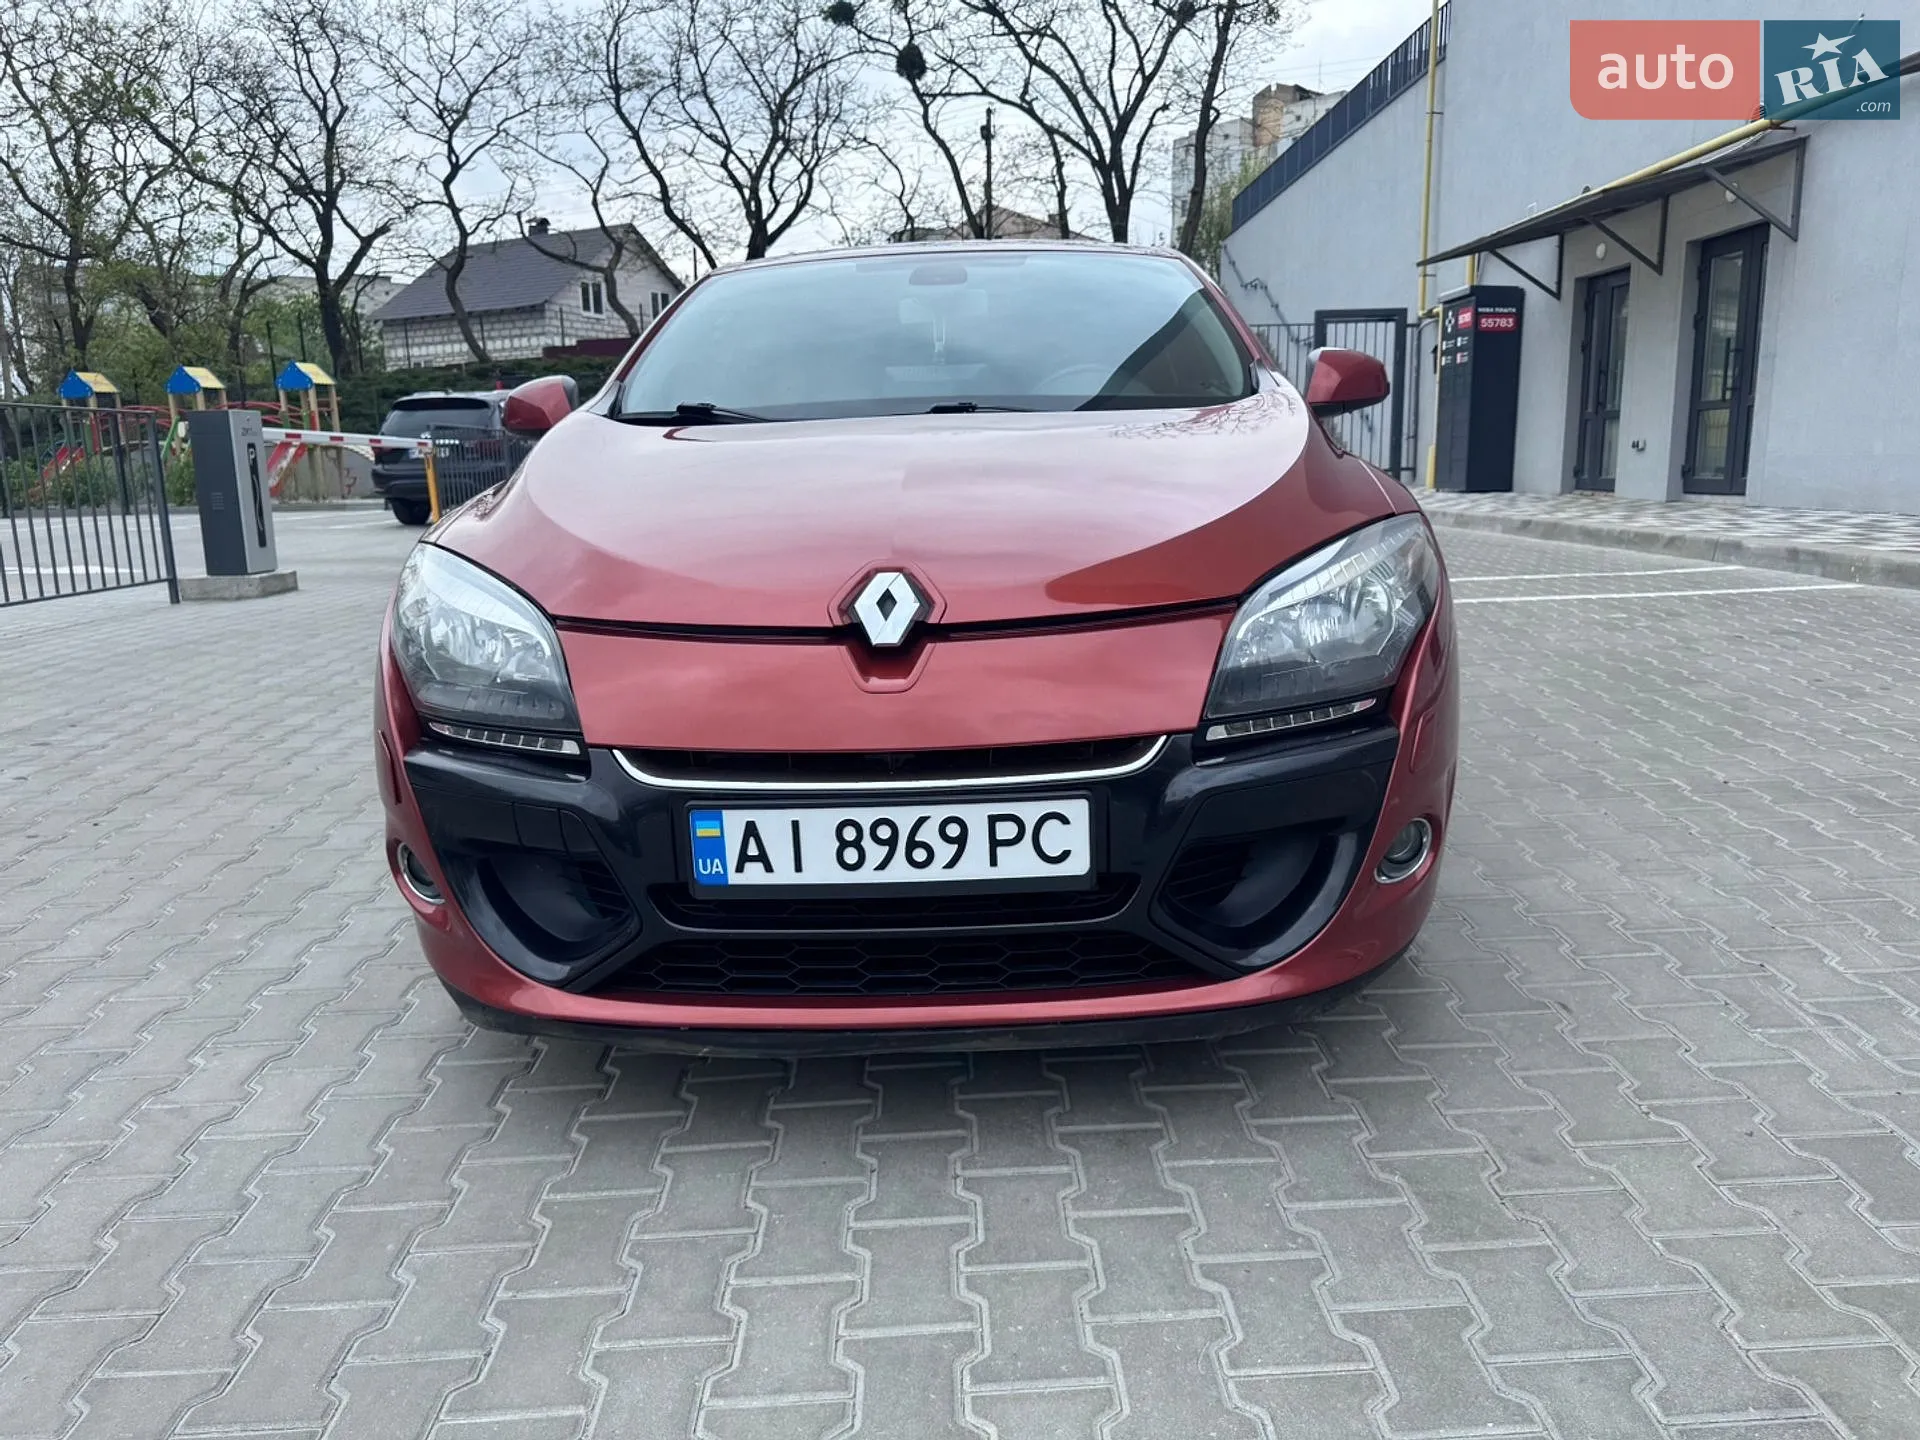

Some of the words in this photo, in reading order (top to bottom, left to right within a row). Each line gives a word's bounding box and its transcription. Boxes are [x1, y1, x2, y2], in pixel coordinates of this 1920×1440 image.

[1480, 318, 1514, 328] 55783
[734, 819, 804, 874] AI
[834, 814, 970, 872] 8969
[986, 810, 1073, 868] PC
[698, 857, 724, 875] UA
